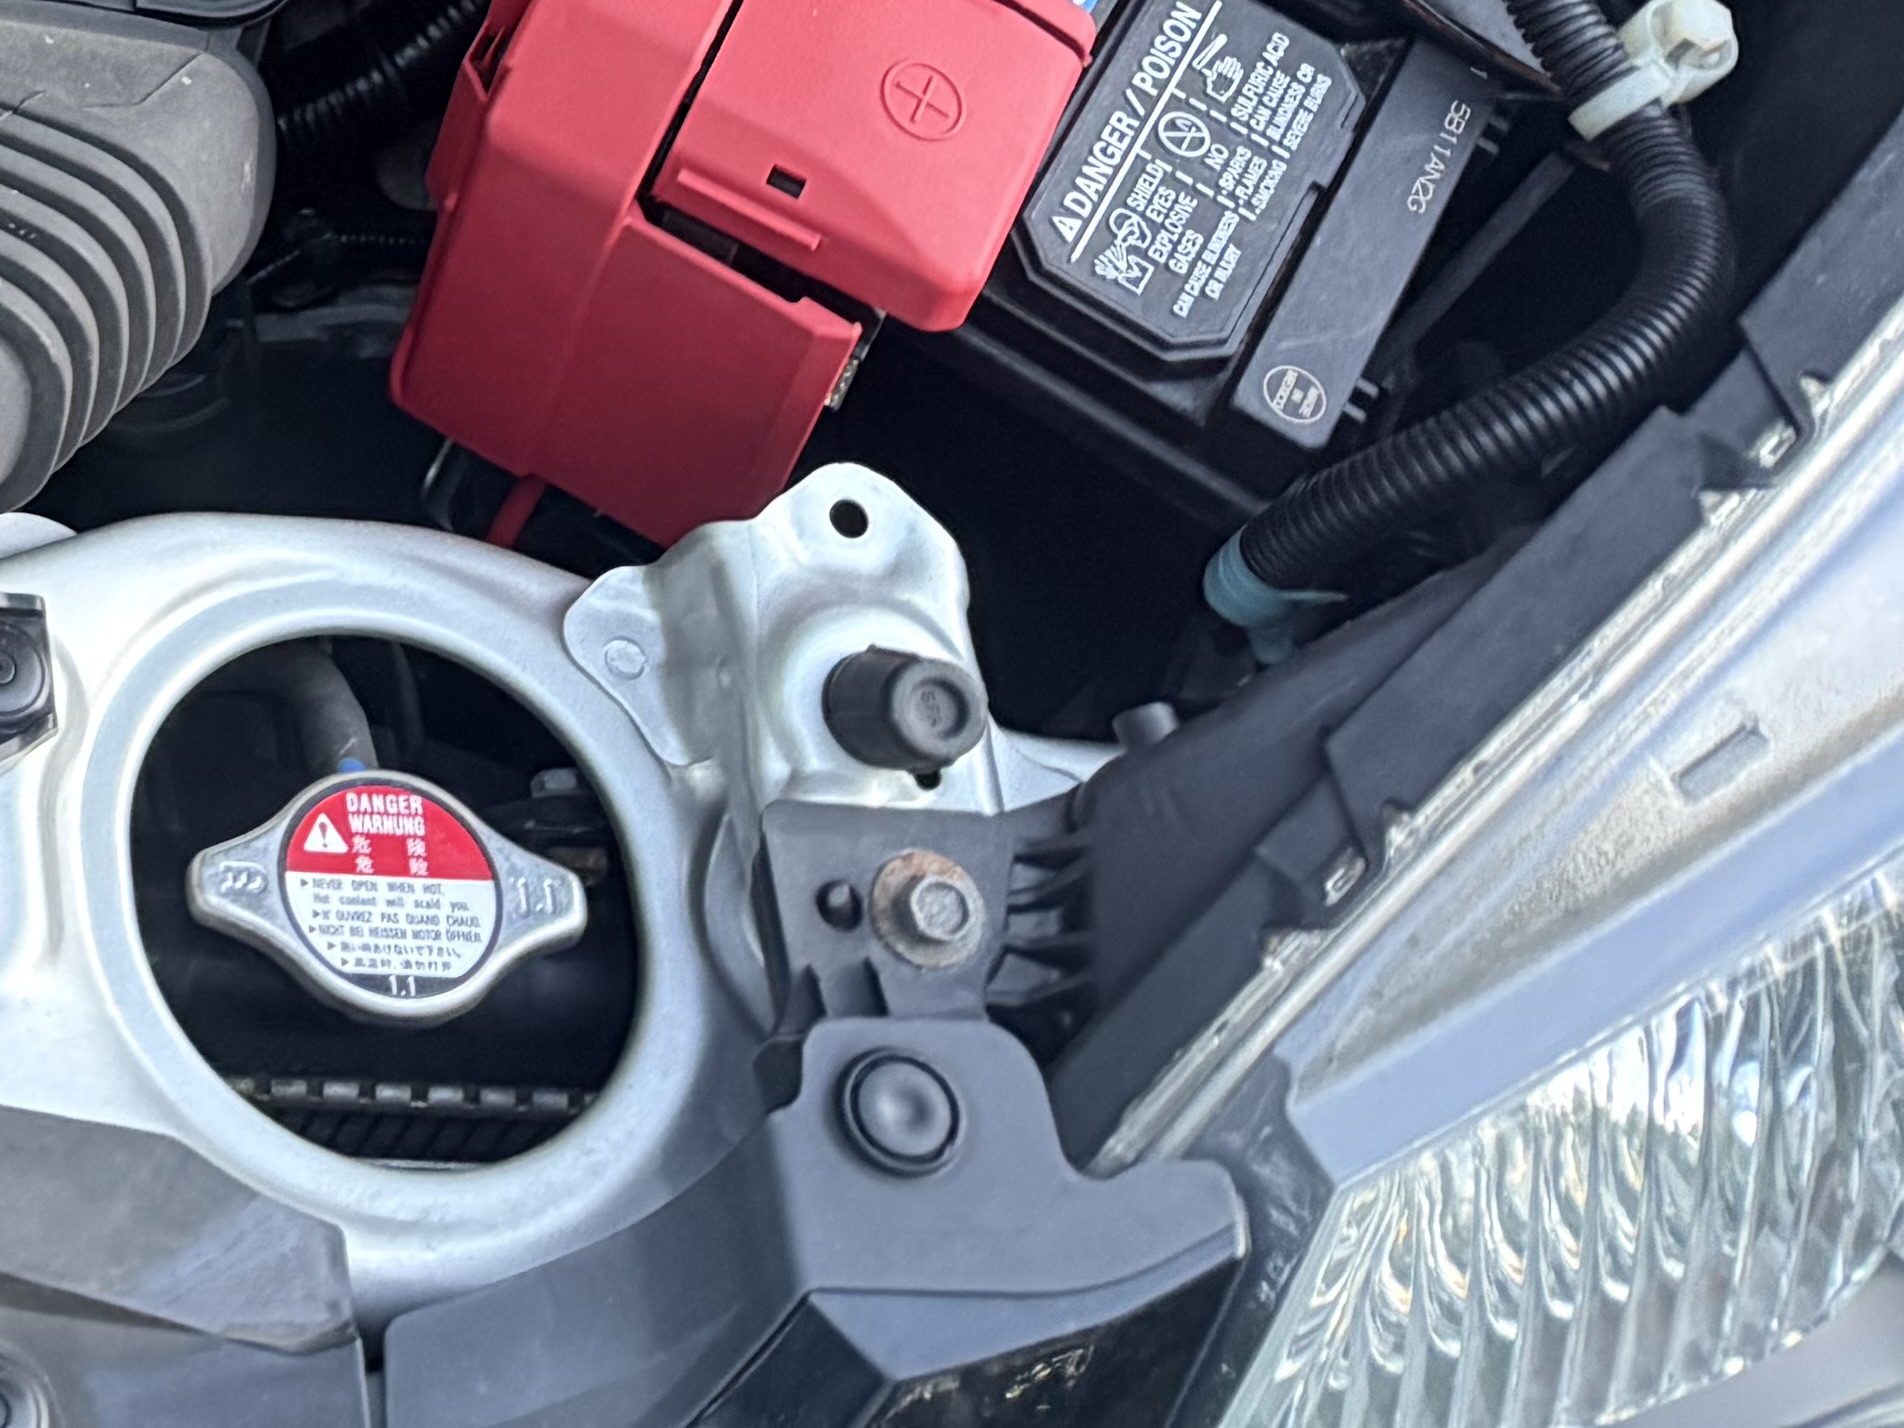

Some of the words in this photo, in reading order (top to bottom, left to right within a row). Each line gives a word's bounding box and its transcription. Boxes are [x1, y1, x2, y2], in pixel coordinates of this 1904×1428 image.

[1230, 60, 1276, 122] SULFURIC
[1261, 31, 1292, 66] ACID
[1061, 109, 1141, 219] DANGER
[1131, 0, 1203, 97] POISON
[1249, 104, 1274, 132] CAN
[1262, 71, 1292, 108] CAUSE
[1204, 142, 1231, 171] NO
[1125, 162, 1166, 213] SHIELD
[1145, 184, 1178, 223] EYES
[1146, 191, 1200, 264] EXPLOSIVE
[1167, 228, 1206, 276] GASES
[346, 792, 423, 813] DANGER
[348, 813, 425, 836] WARNUNG
[312, 879, 343, 889] NEVER
[351, 880, 377, 892] OPEN
[387, 881, 415, 893] WHEN
[381, 913, 400, 924] PAS
[412, 928, 441, 940] MOTOR
[388, 974, 416, 997] 1.1
